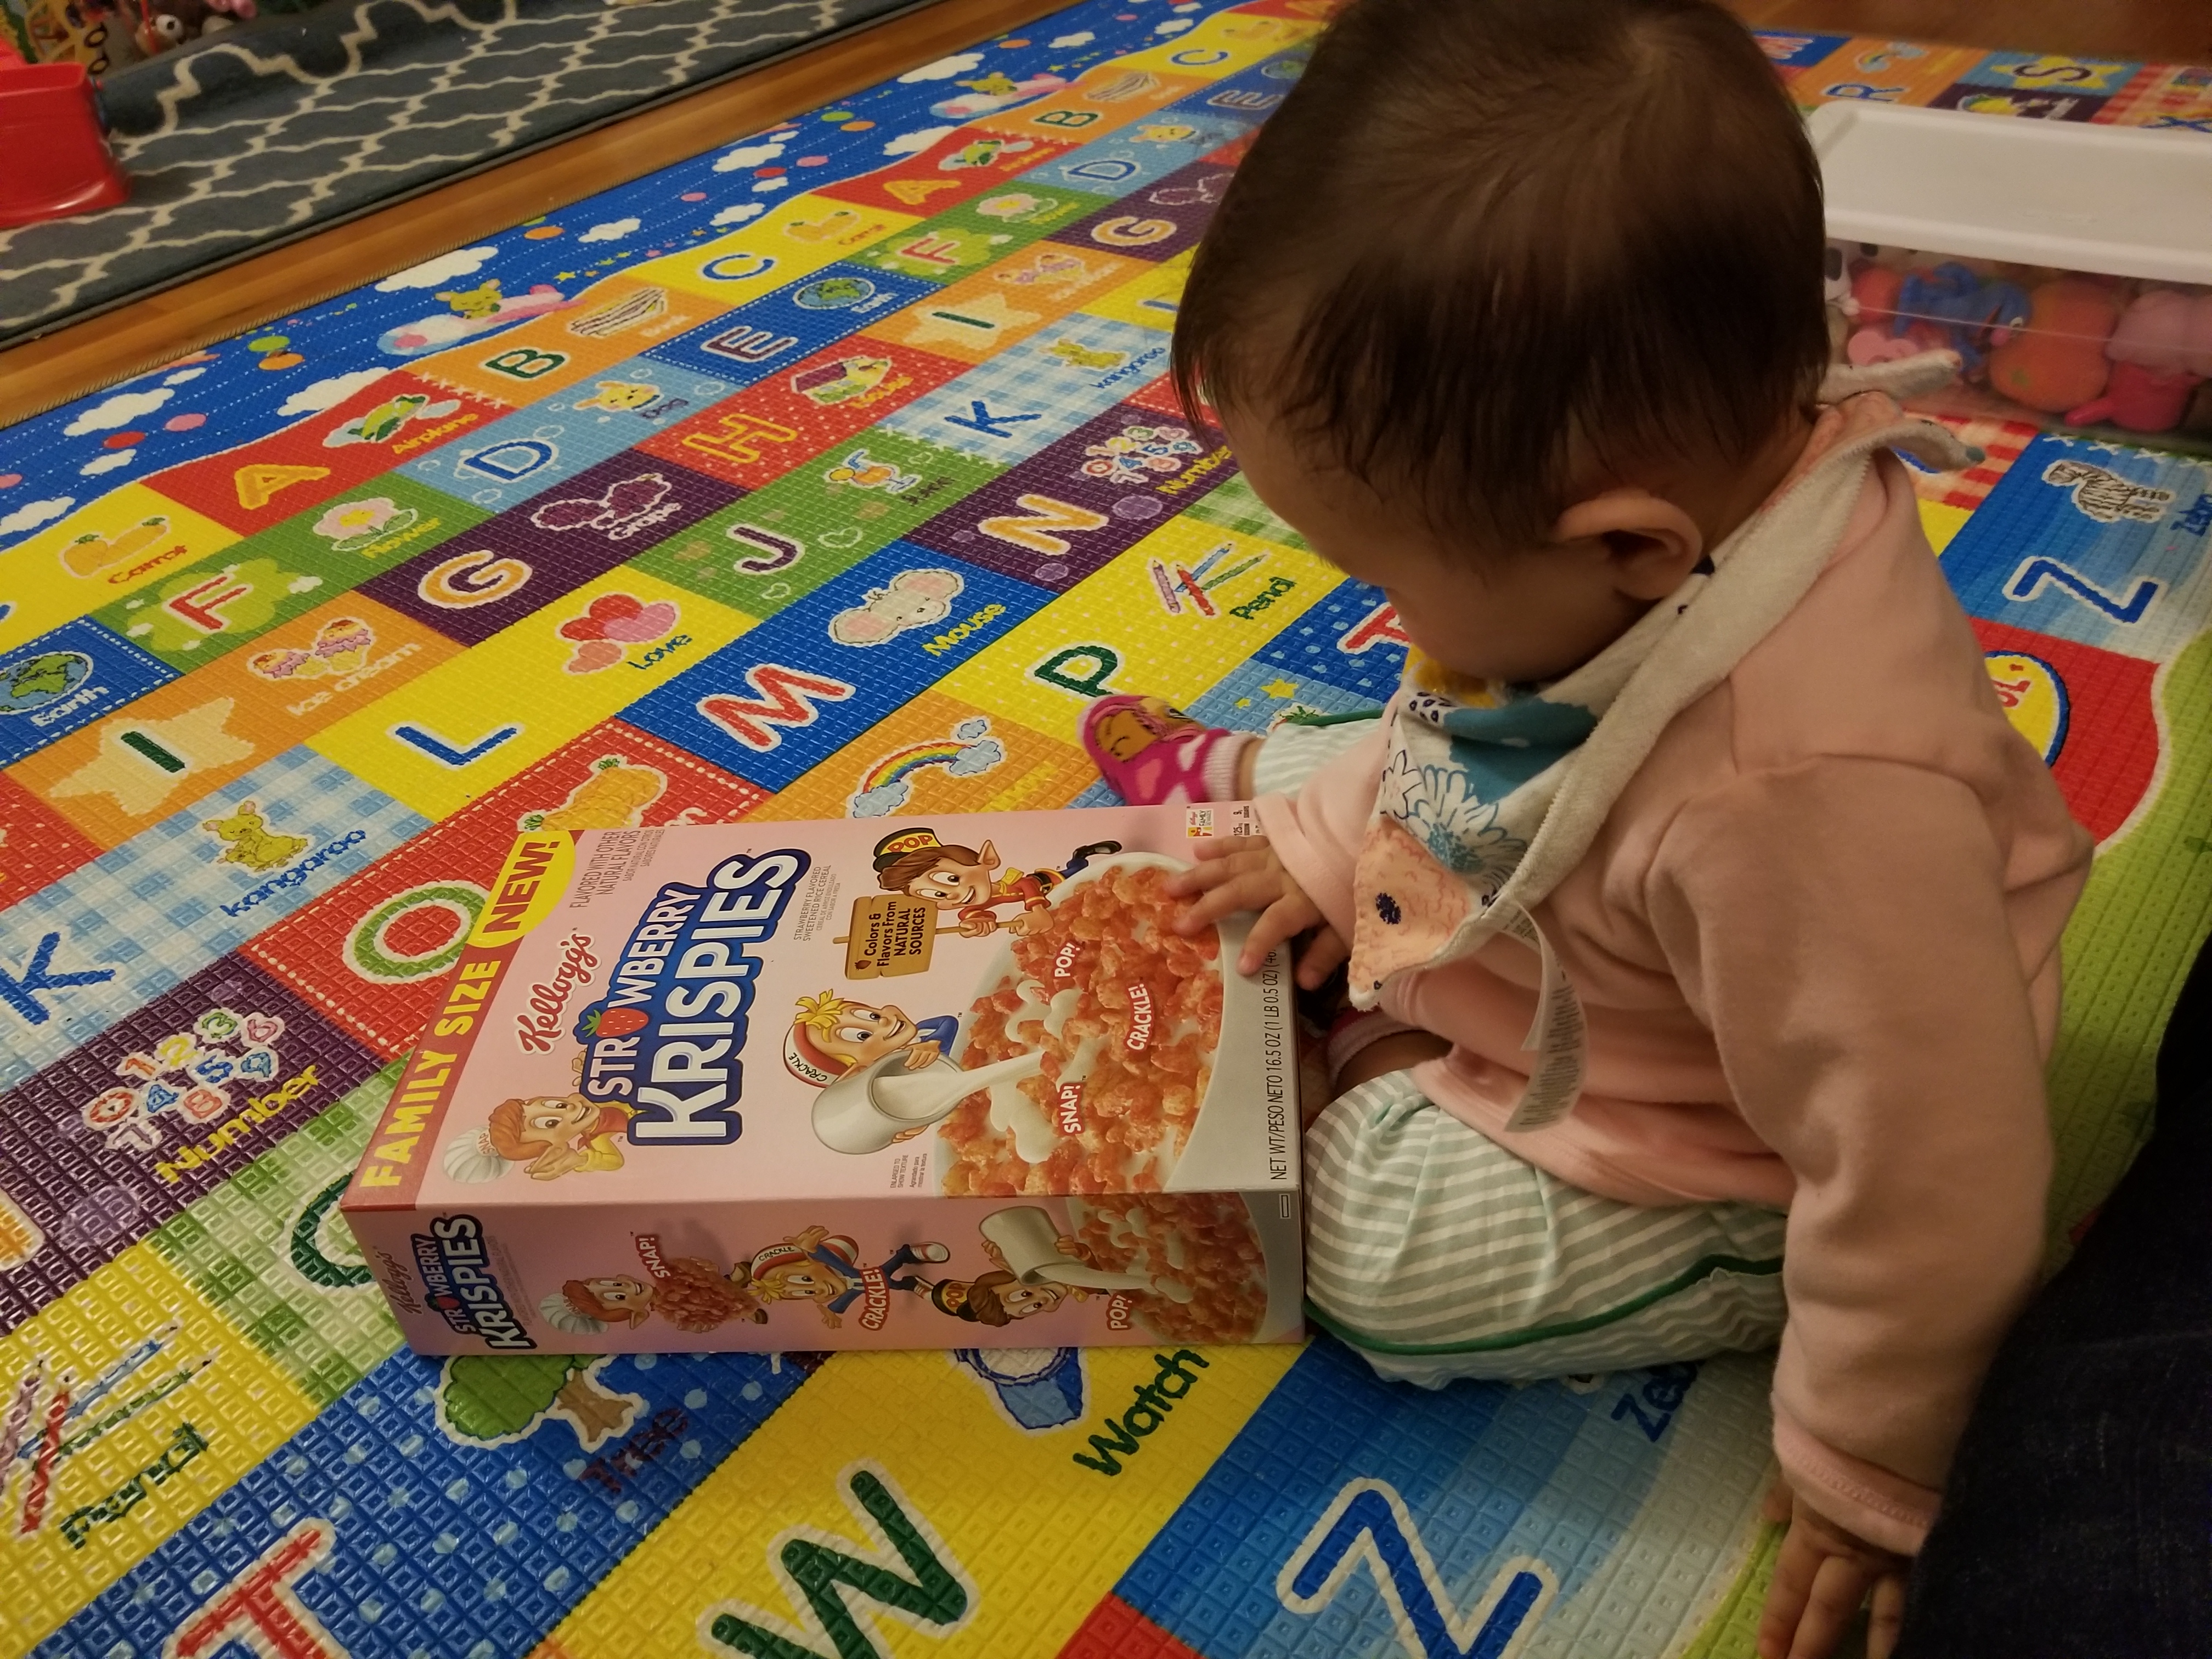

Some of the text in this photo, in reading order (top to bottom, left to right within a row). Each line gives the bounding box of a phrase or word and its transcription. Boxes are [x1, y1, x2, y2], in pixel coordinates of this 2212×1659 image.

[2013, 64, 2091, 82] S
[1034, 110, 1099, 127] B
[882, 179, 961, 205] A
[1068, 160, 1136, 180] D
[900, 238, 956, 264] F
[1091, 217, 1177, 246] G
[702, 253, 775, 280] C
[484, 348, 566, 379] B
[706, 327, 793, 360] E
[392, 413, 479, 455] Airplane
[682, 413, 799, 464] H
[945, 400, 1042, 438] K
[463, 440, 552, 481] D
[234, 464, 330, 510] A
[980, 495, 1103, 553] N
[730, 525, 803, 573] J
[168, 574, 250, 631] F
[421, 552, 530, 606] G
[2012, 559, 2159, 624] Z
[627, 634, 692, 670] Love
[922, 603, 1007, 658] Mouse
[1033, 645, 1119, 698] P
[31, 685, 110, 727] Earth
[702, 666, 847, 747] M
[394, 726, 518, 765] L
[595, 830, 641, 895] NATURAL FLAVORS
[888, 834, 933, 854] POP
[482, 840, 561, 934] NEW!
[569, 831, 623, 908] FLAVORED WITH OTHER
[793, 866, 821, 940] STRAWBERRY FLAVORED
[803, 865, 832, 941] SWEETENED RICE CEREAL
[353, 884, 487, 978] O
[864, 922, 881, 956] Colors
[877, 901, 897, 967] Flavors From
[893, 908, 911, 956] NATURAL
[909, 907, 926, 955] SOURCES
[0, 932, 116, 1025] K
[1054, 941, 1081, 979] POP!
[1262, 969, 1281, 986] OZ)
[517, 932, 599, 1053] Kellogg's
[635, 855, 799, 1139] KRISPIES
[1127, 981, 1153, 1051] CRACKLE!
[1263, 988, 1279, 1003] 0.5
[1264, 1005, 1279, 1018] LB
[1263, 1021, 1283, 1031] (1
[1265, 1032, 1281, 1047] OZ
[359, 960, 501, 1189] FAMILY SIZE
[788, 1051, 828, 1083] CRACKLE
[1265, 1049, 1282, 1071] 16.5
[1061, 1084, 1082, 1134] SNAP!
[1266, 1075, 1283, 1103] NETO
[154, 1065, 319, 1183] Number
[1268, 1105, 1286, 1154] WT/PESO
[1269, 1156, 1288, 1180] NET
[639, 1237, 671, 1278] SNAP!
[758, 1245, 795, 1262] CRACKLE
[380, 1250, 422, 1315] Kellogg's
[435, 1214, 531, 1348] KRISPIES
[861, 1268, 887, 1330] CRACKLE!
[946, 1282, 967, 1308] POP
[1110, 1294, 1132, 1330] POP!
[1071, 1350, 1210, 1476] Watch
[710, 1469, 968, 1659] W
[1291, 1488, 1544, 1659] Z
